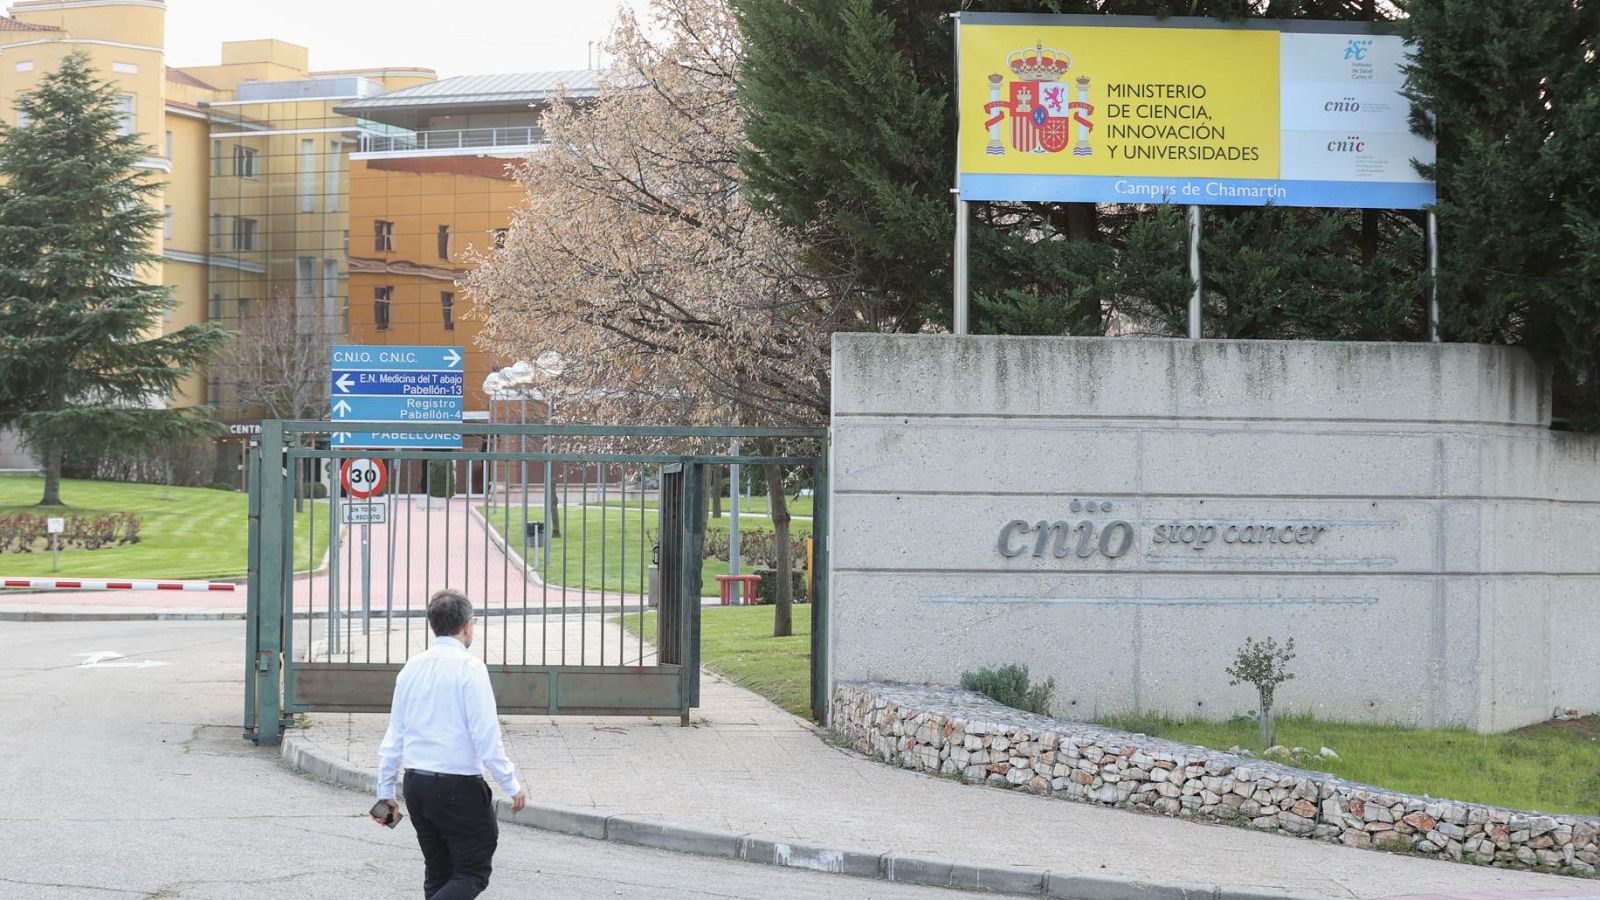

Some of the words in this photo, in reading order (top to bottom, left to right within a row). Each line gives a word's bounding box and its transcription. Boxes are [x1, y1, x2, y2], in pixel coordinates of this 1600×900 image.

[1107, 84, 1206, 98] MINISTERIO
[1324, 97, 1360, 112] cnio
[1107, 104, 1130, 118] DE
[1136, 104, 1212, 120] CIENCIA,
[1107, 122, 1225, 140] INNOVACIÓN
[1327, 136, 1365, 152] cnic
[1107, 145, 1118, 159] Y
[1124, 145, 1259, 161] UNIVERSIDADES
[1114, 180, 1176, 199] Campus
[1182, 182, 1200, 196] de
[1206, 182, 1287, 198] Chamartín
[333, 352, 373, 363] C.N.I.O.
[379, 352, 418, 363] C.N.I.C.
[360, 373, 377, 383] E.N.
[380, 374, 416, 383] Medicina
[417, 374, 430, 383] del
[403, 385, 462, 395] Pabellón-13
[407, 399, 456, 410] Registro
[400, 409, 461, 419] Pabellón-4
[230, 424, 262, 434] CENTR
[371, 431, 461, 440] PABELLONES
[350, 469, 376, 483] 30
[998, 500, 1135, 559] cnio
[1153, 525, 1217, 551] stop
[1223, 525, 1327, 544] cancer
